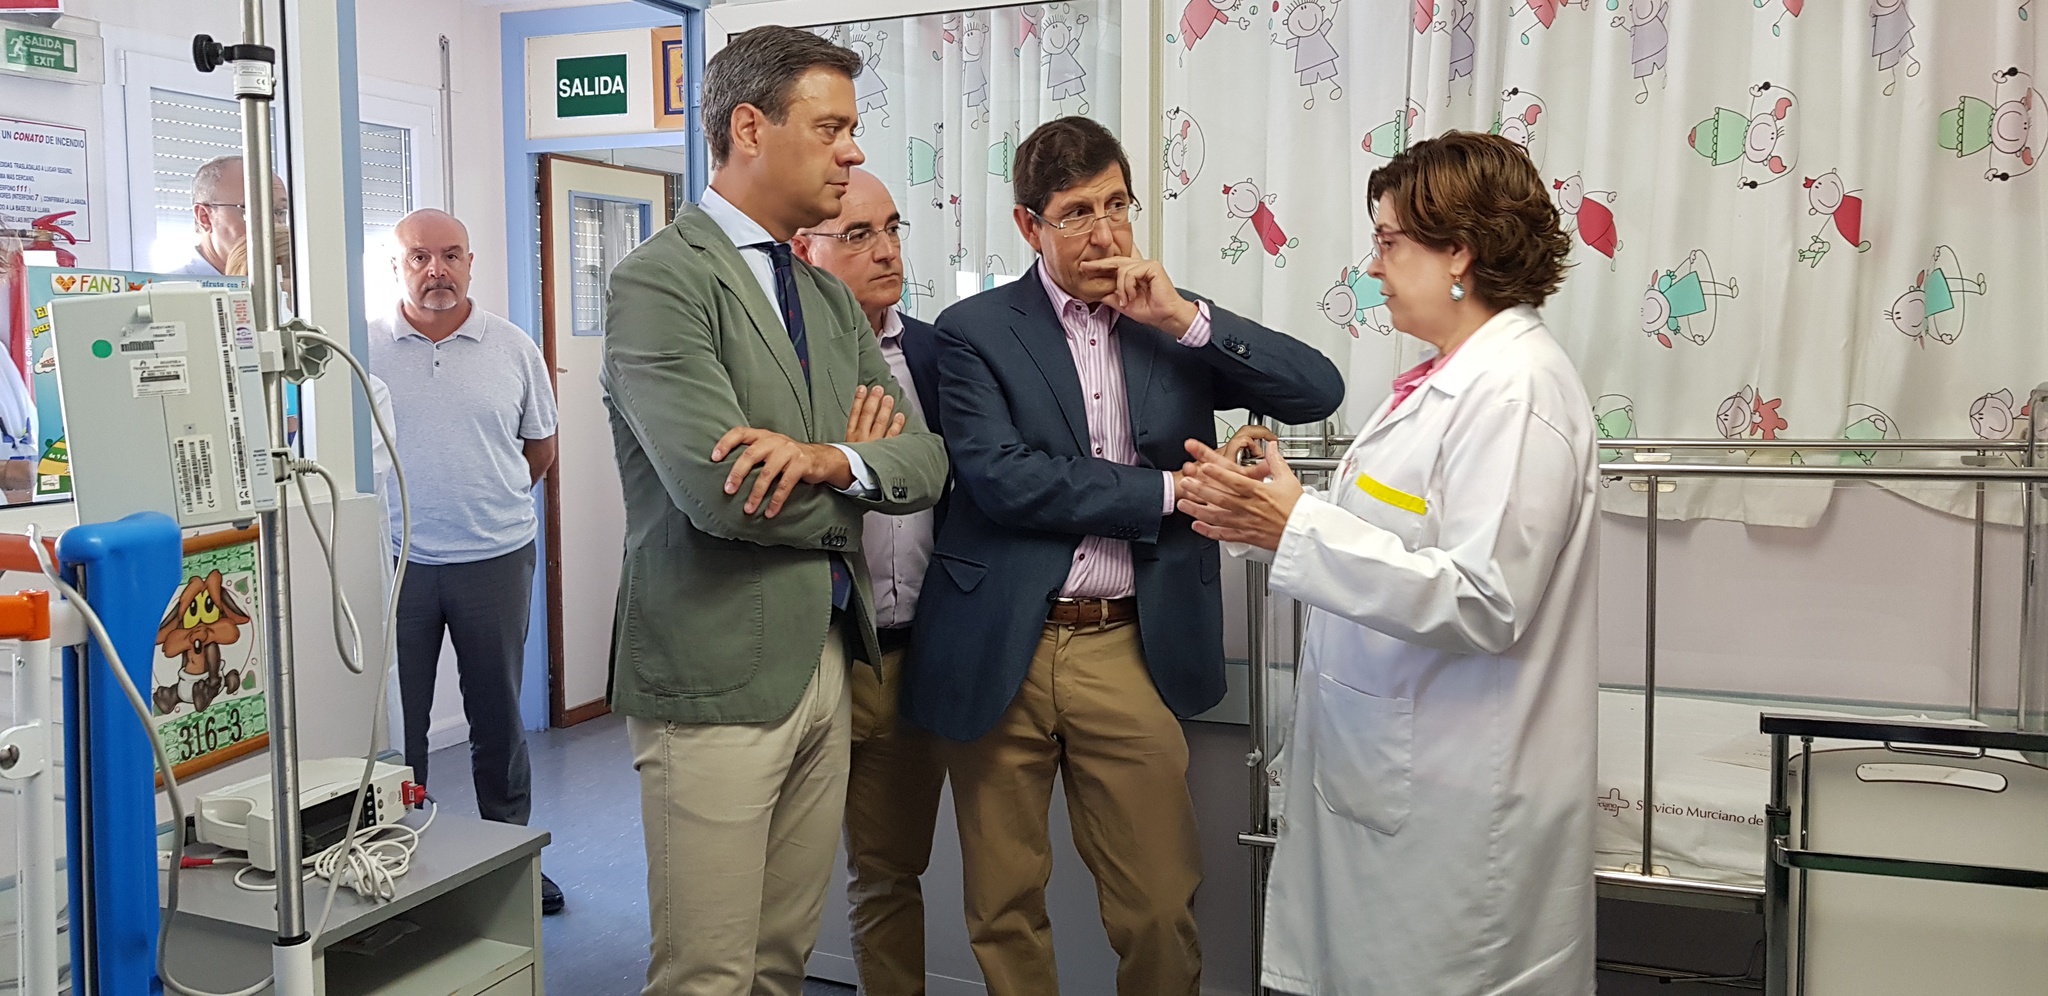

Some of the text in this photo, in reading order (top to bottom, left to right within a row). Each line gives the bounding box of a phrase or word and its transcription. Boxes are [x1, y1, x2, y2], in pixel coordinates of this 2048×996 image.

[24, 35, 62, 50] SALIDA
[33, 55, 55, 68] EXIT
[559, 75, 625, 98] SALIDA
[2, 129, 84, 148] UN CONATO DE INCENDIO
[16, 185, 28, 193] 111
[80, 275, 120, 293] FAN3
[180, 708, 242, 761] 316-3
[1635, 799, 1764, 826] Svicio Murciano de
